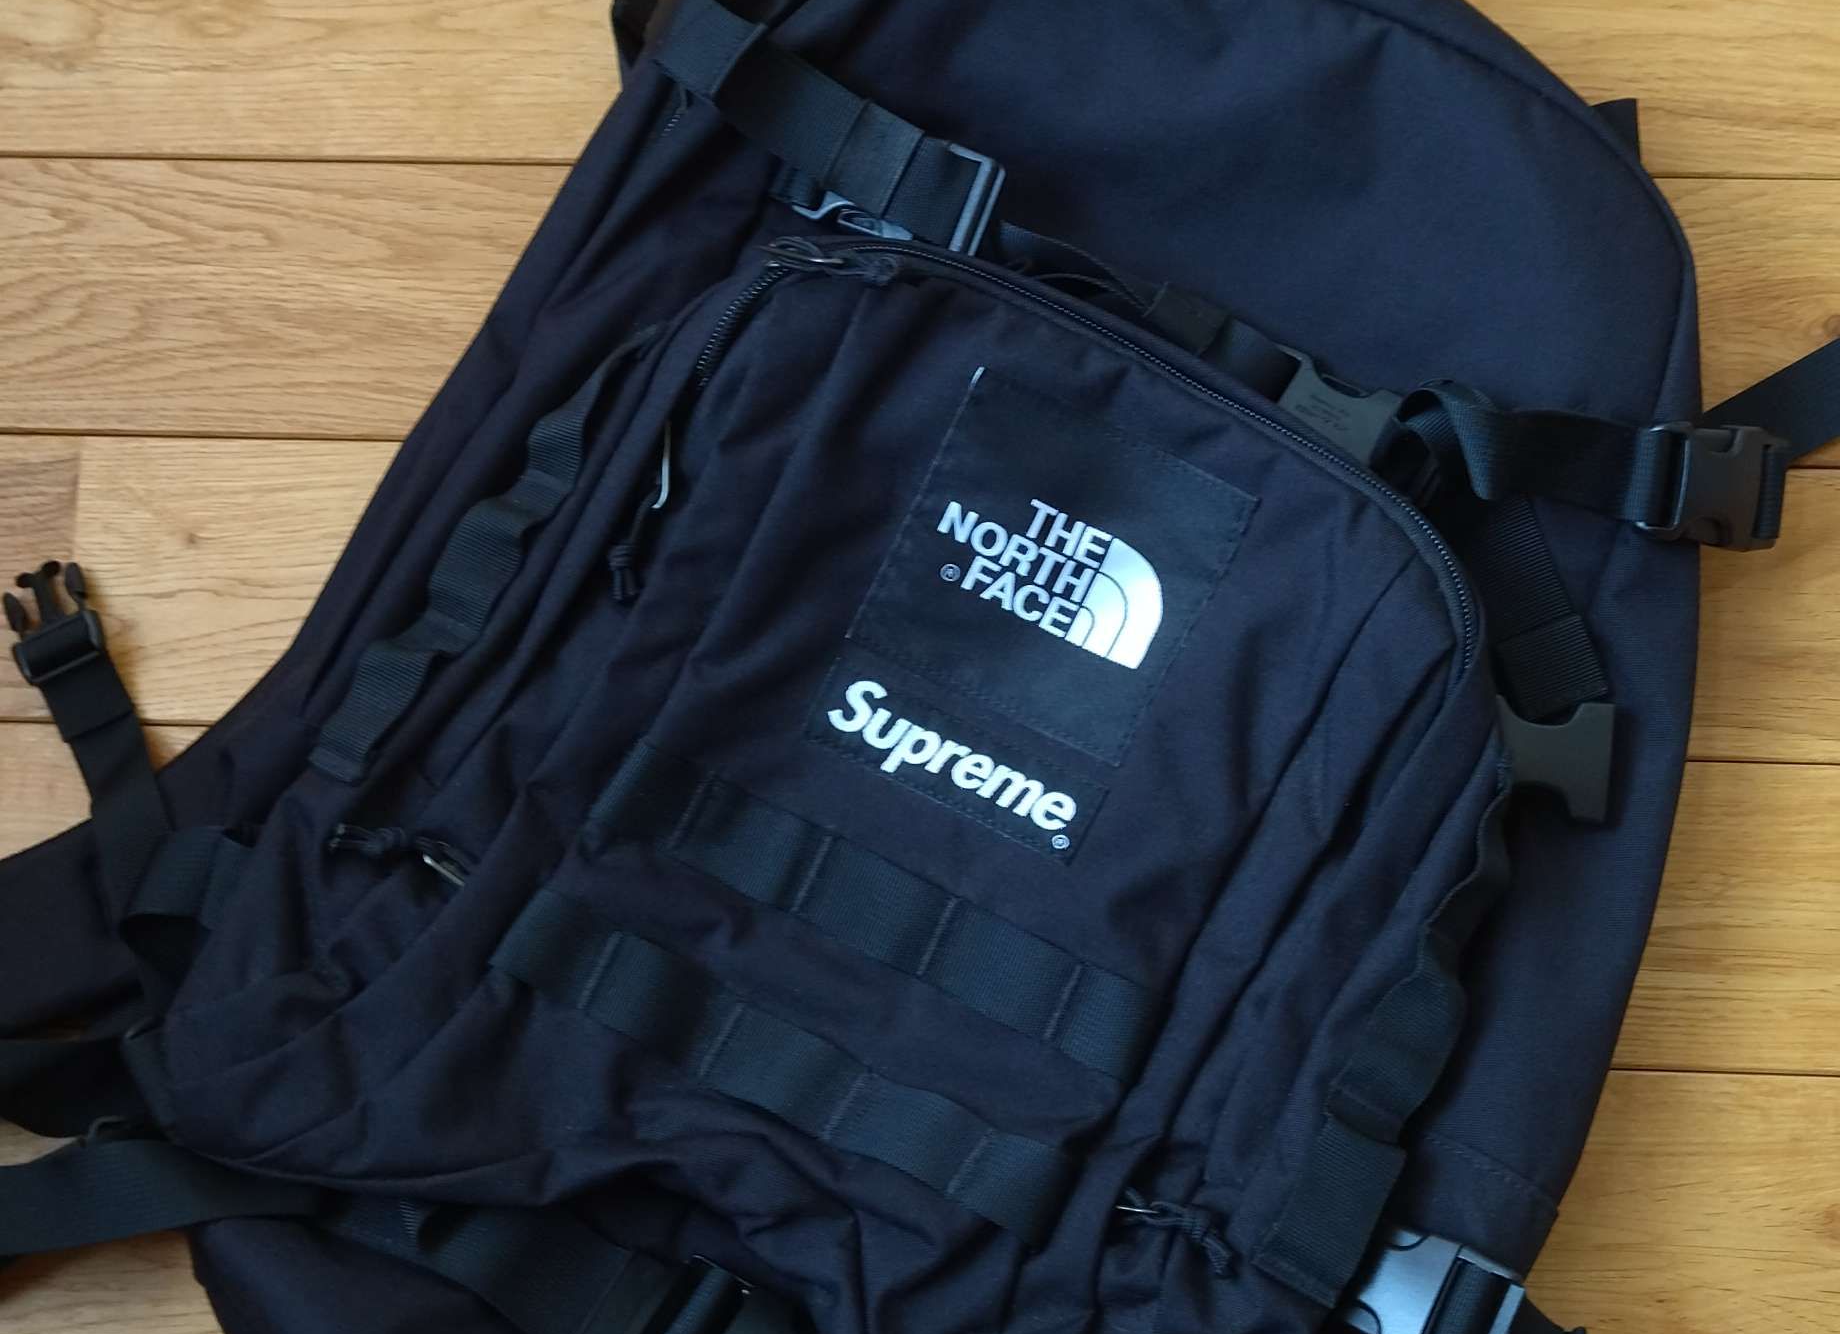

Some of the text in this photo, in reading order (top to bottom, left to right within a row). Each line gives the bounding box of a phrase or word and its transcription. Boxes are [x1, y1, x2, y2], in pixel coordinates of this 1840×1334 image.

[936, 501, 1096, 603] NORTH
[1025, 498, 1113, 569] THE
[960, 556, 1079, 639] FACE
[827, 680, 1077, 831] Supreme
